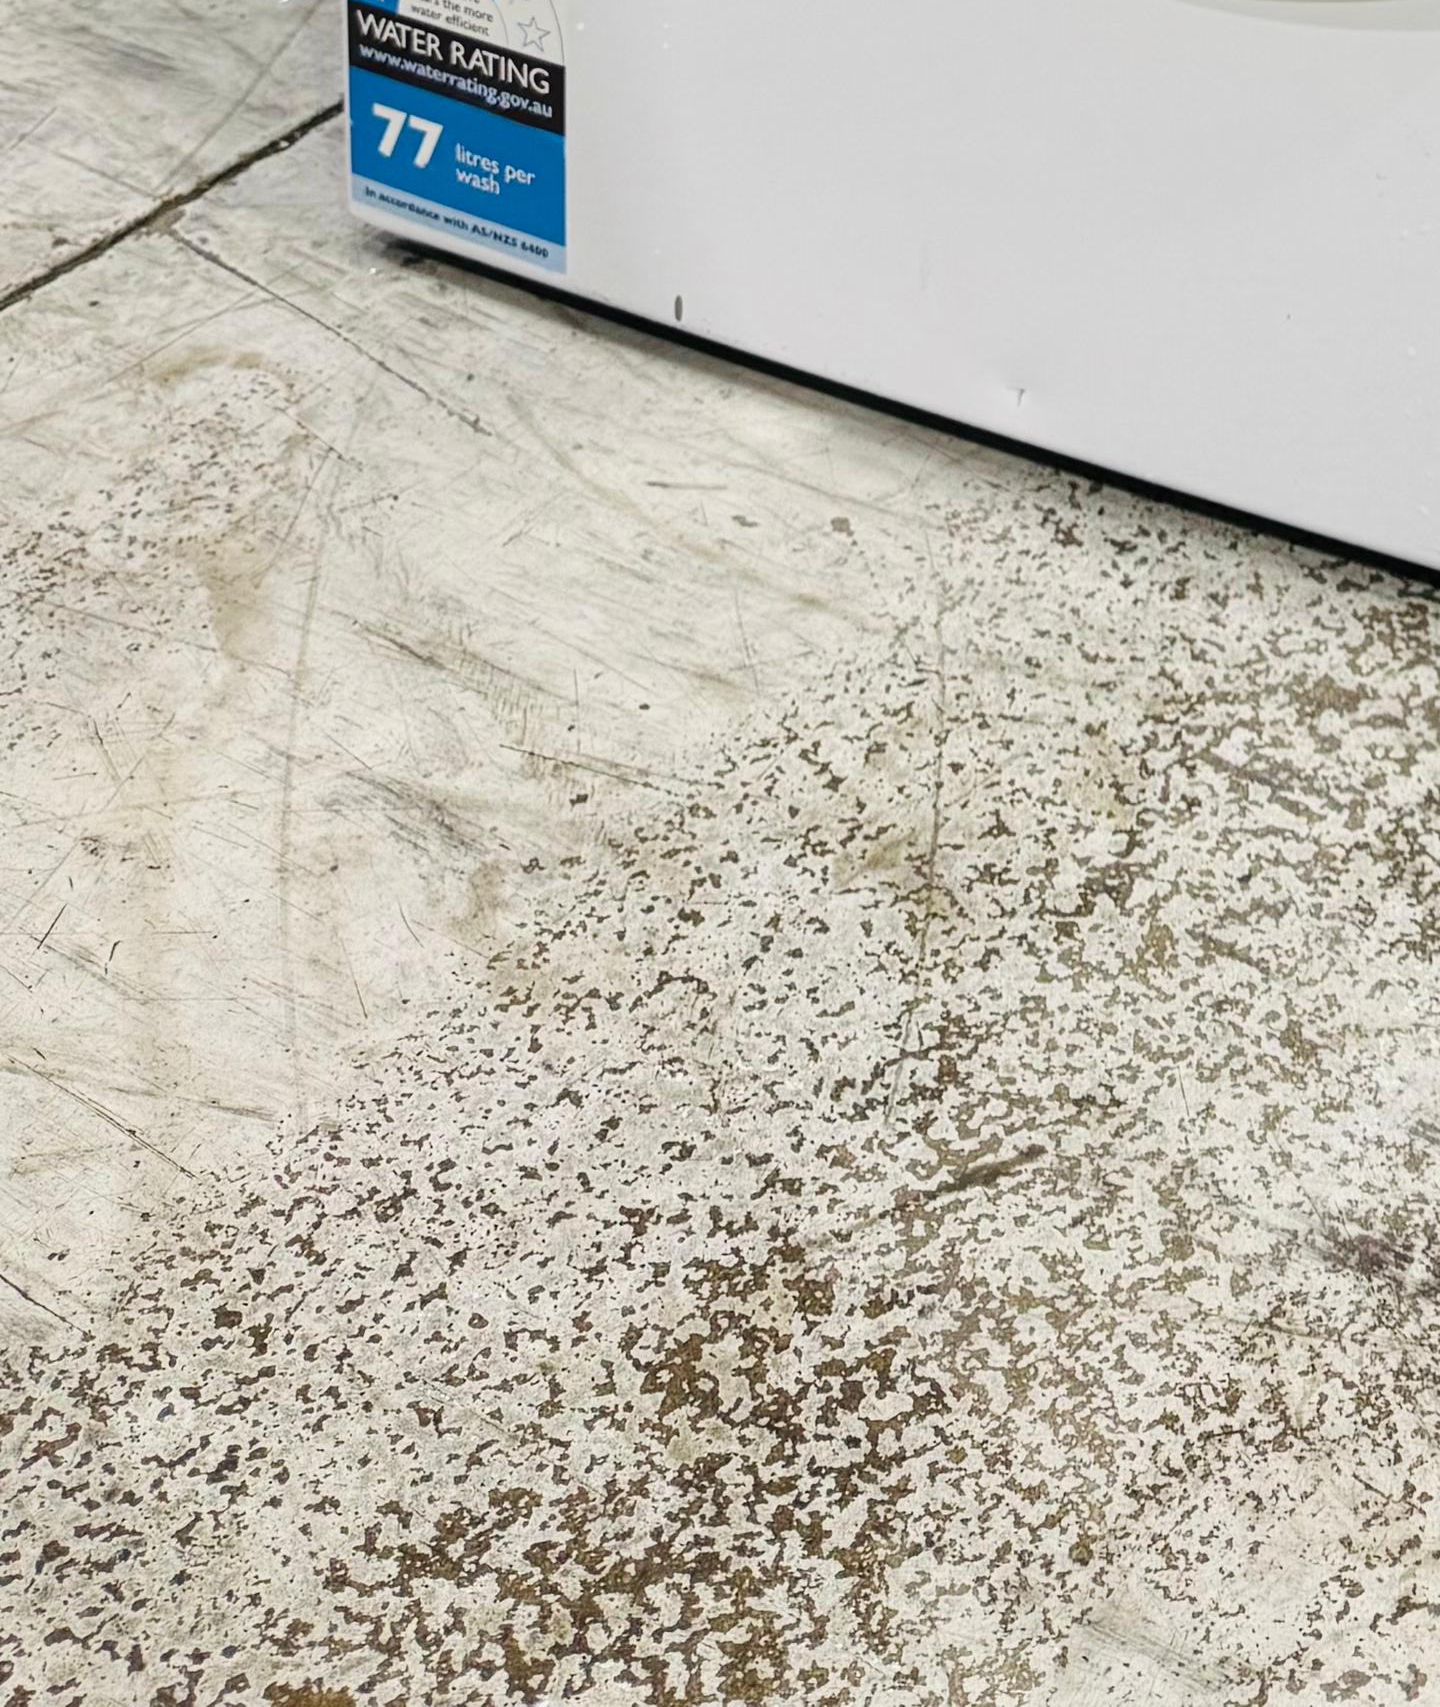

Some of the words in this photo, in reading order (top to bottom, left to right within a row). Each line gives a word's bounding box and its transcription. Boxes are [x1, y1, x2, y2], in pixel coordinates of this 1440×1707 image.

[411, 5, 442, 20] water
[446, 14, 490, 37] efficient
[464, 6, 494, 22] more
[356, 9, 443, 61] WATER
[450, 40, 550, 95] RATING
[359, 43, 553, 118] www.waterrating.gov.au
[372, 101, 444, 169] 77
[454, 142, 500, 175] litres
[504, 164, 536, 186] per
[455, 168, 500, 195] wash
